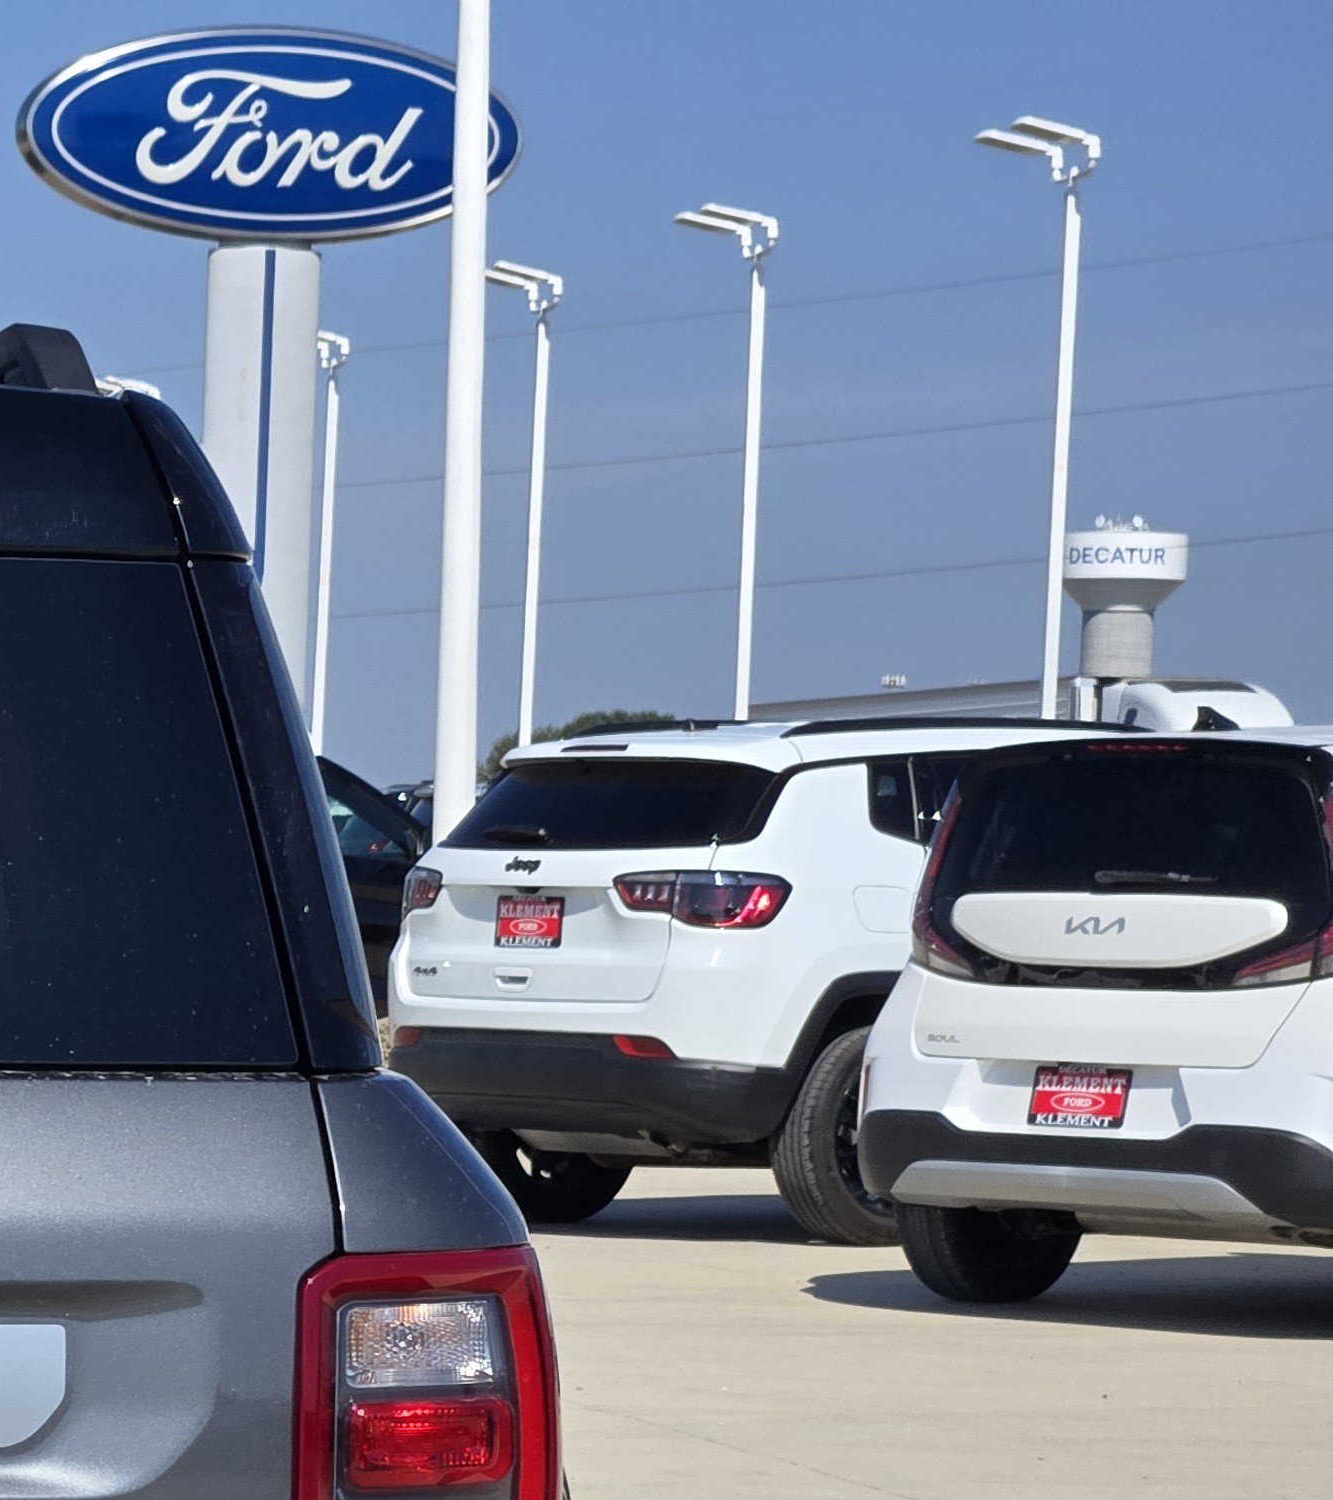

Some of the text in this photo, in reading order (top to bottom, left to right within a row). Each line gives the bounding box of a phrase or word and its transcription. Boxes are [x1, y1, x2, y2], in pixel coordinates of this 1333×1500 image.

[135, 69, 423, 191] Ford
[1068, 547, 1166, 565] DECATUR
[505, 856, 541, 875] Jeep
[499, 903, 560, 919] KLEMENT
[1064, 916, 1126, 935] KIA
[500, 936, 553, 947] KLEMENT
[1035, 1074, 1127, 1095] KLEMENT
[1062, 1097, 1093, 1107] FORD
[1035, 1113, 1113, 1128] KLEMENT
